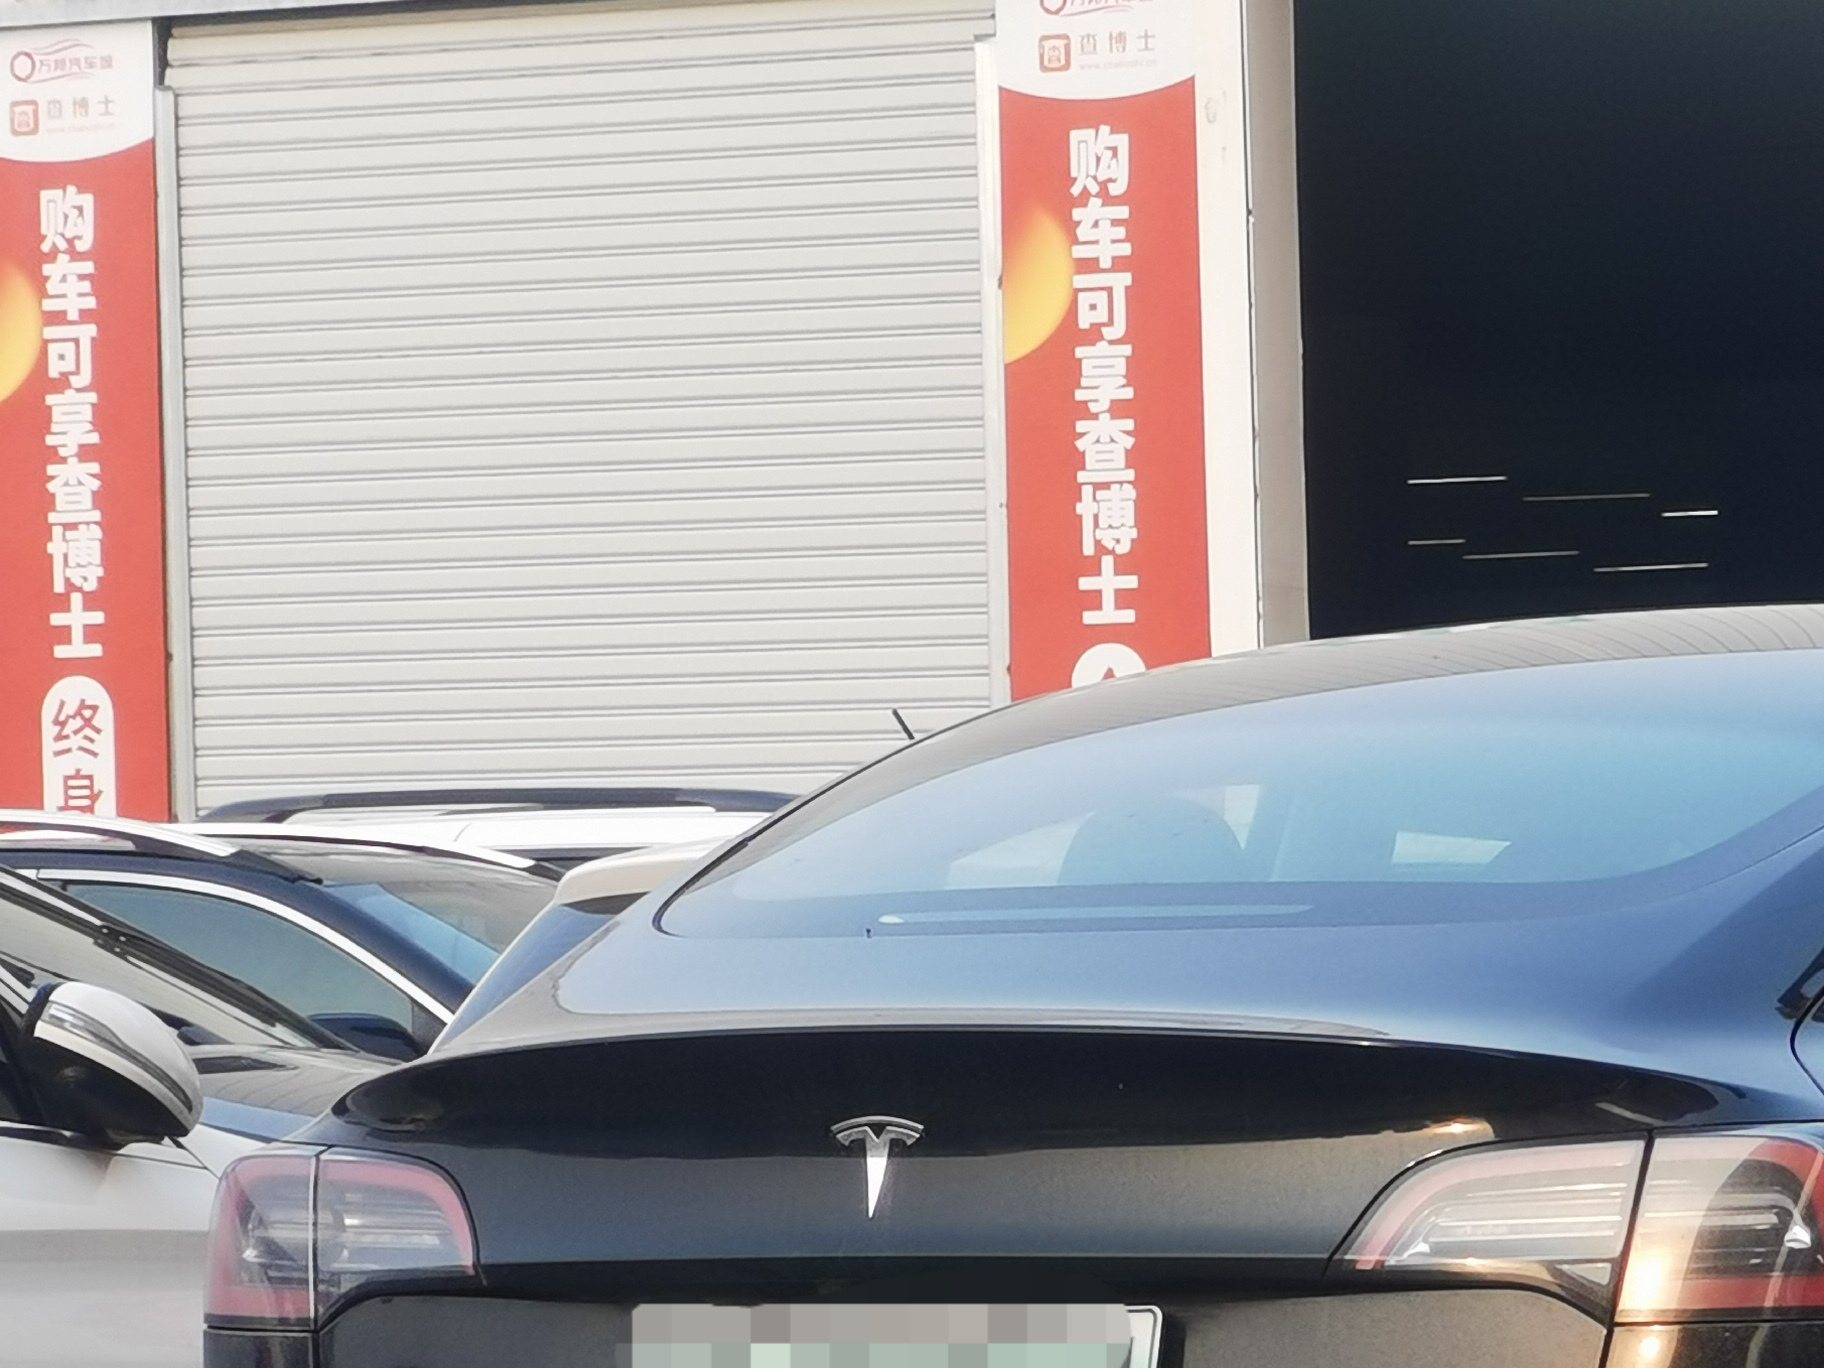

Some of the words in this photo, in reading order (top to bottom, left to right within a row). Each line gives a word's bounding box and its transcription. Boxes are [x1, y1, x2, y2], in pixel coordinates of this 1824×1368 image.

[1079, 29, 1156, 56] 查博士
[39, 185, 105, 659] 购车可享查博士
[1068, 124, 1139, 625] 购车可享查博士
[51, 697, 105, 815] 终身
